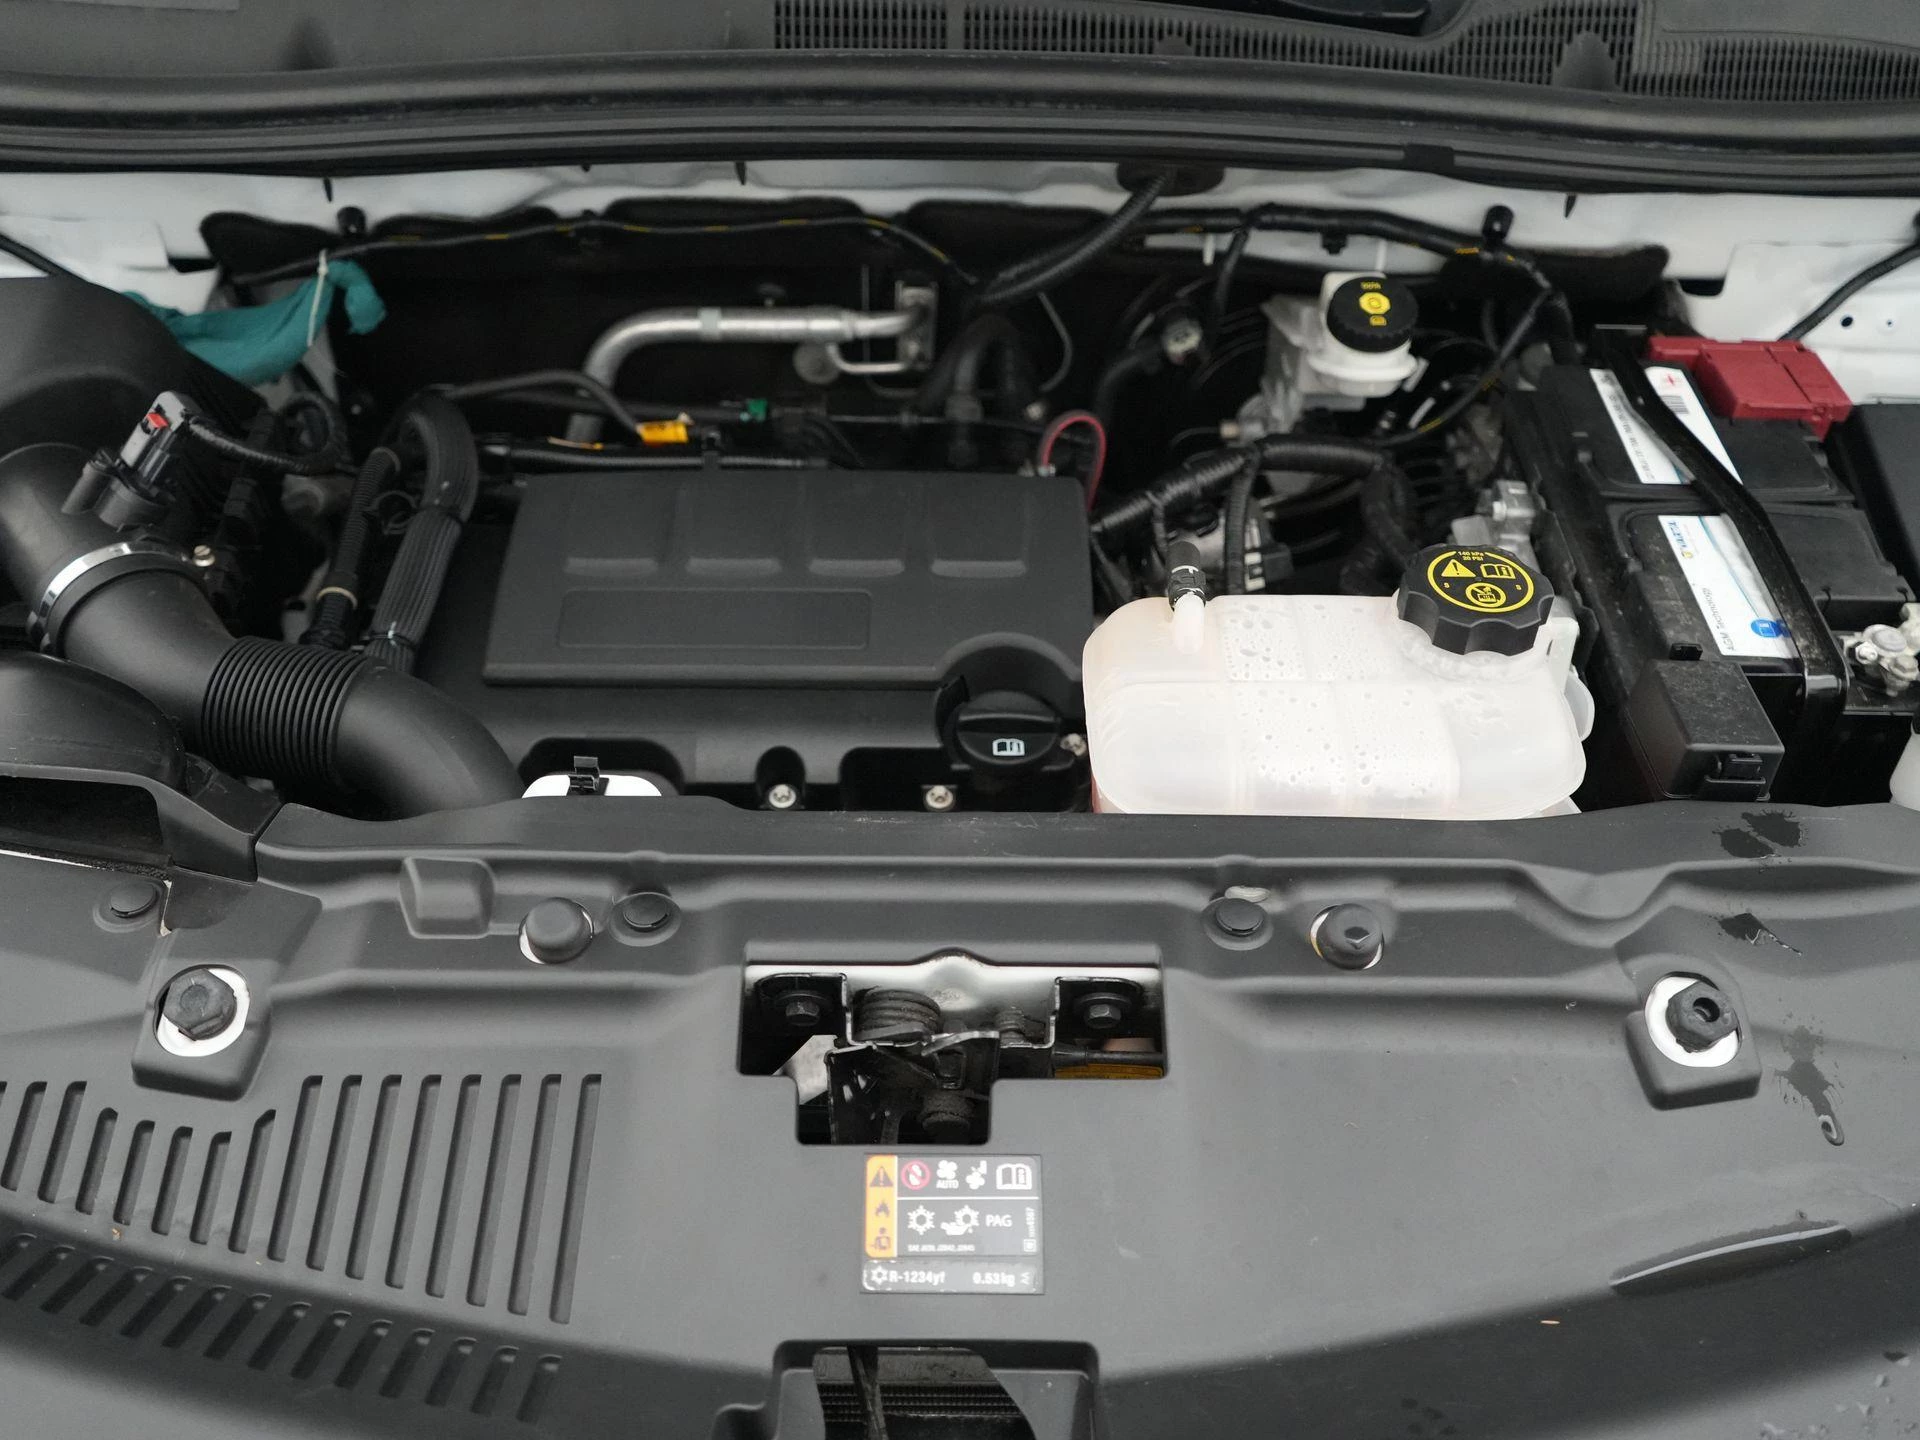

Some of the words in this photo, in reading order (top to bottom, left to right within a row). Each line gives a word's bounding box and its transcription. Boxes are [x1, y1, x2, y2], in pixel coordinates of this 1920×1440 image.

[936, 1179, 959, 1189] AUTO
[985, 1214, 1013, 1227] PAG
[889, 1271, 946, 1286] R-1234yf
